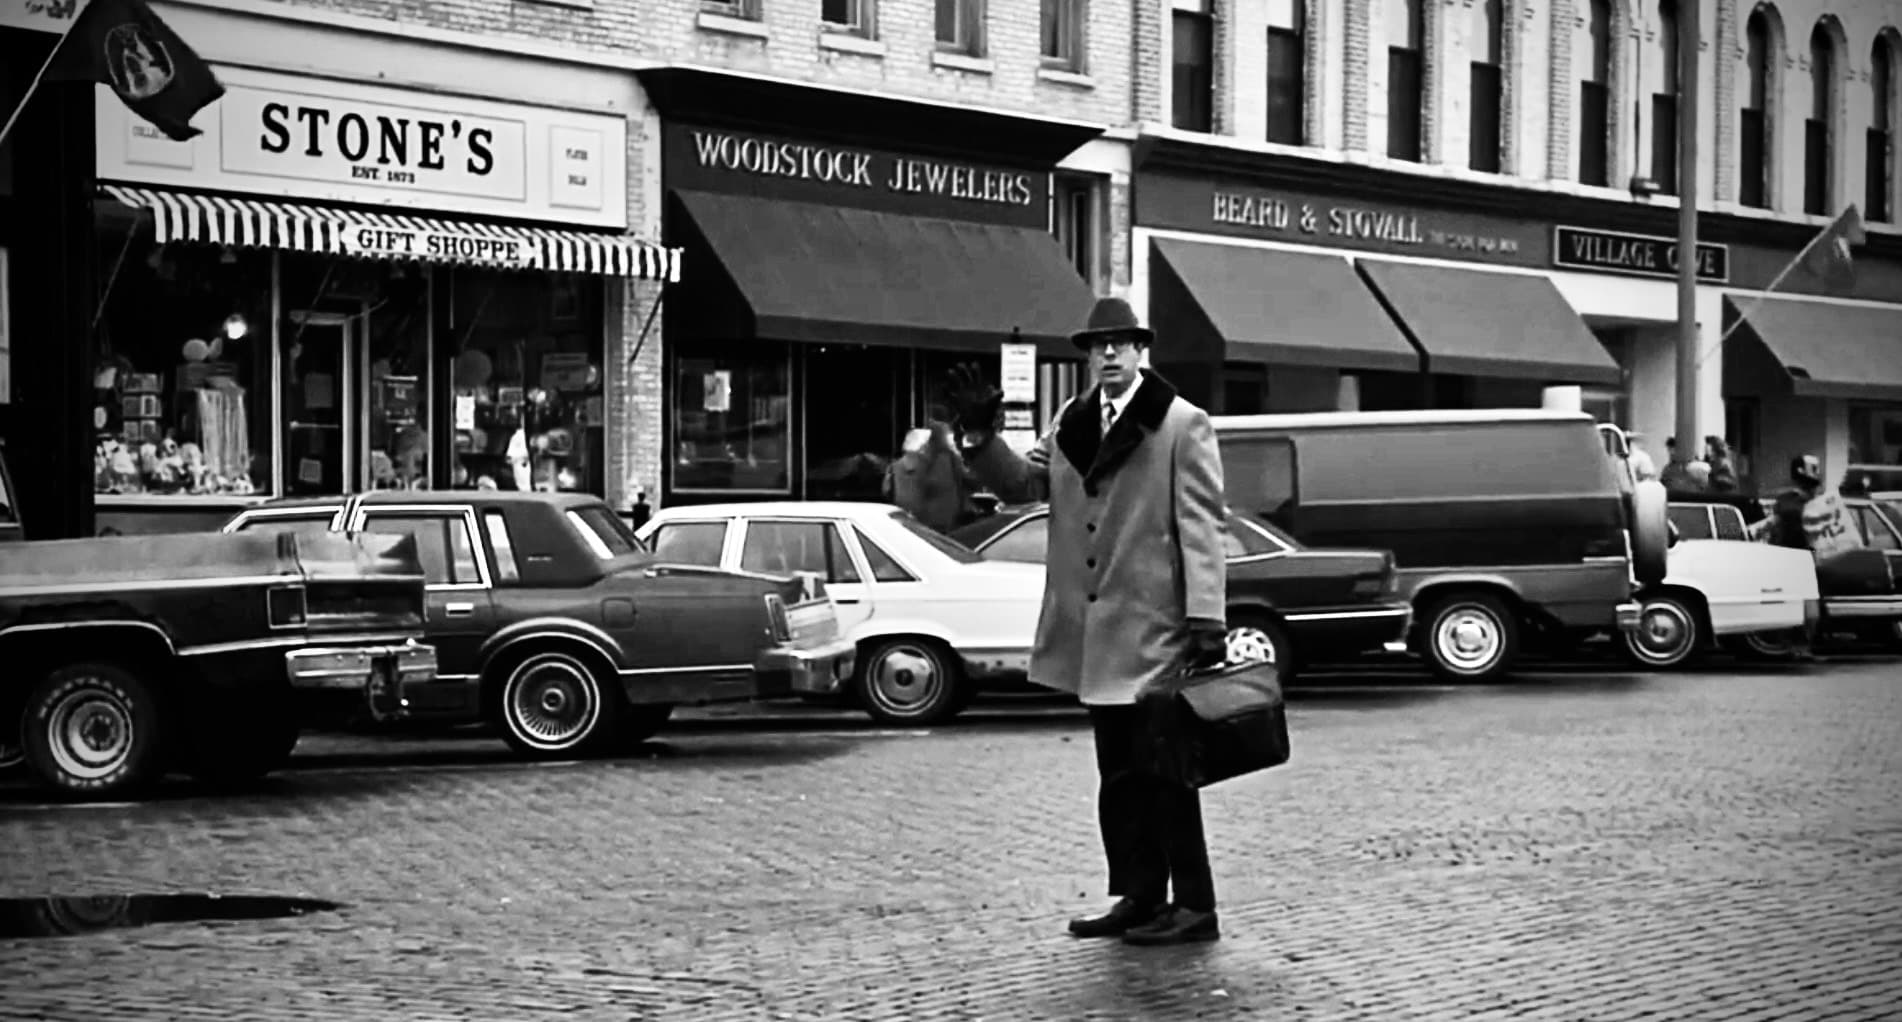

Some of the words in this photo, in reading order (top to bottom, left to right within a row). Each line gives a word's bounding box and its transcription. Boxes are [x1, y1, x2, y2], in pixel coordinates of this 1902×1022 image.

[260, 102, 495, 176] STONE'S
[694, 131, 872, 187] WOODSTOCK
[888, 158, 1032, 206] JEWELERS
[1213, 192, 1289, 229] BEARD
[1300, 203, 1320, 233] &
[1329, 207, 1424, 243] STOVALL
[357, 228, 416, 252] GIFT
[427, 234, 520, 261] SHOPPE
[1572, 234, 1656, 269] VILLAGE
[1666, 245, 1717, 274] CVE
